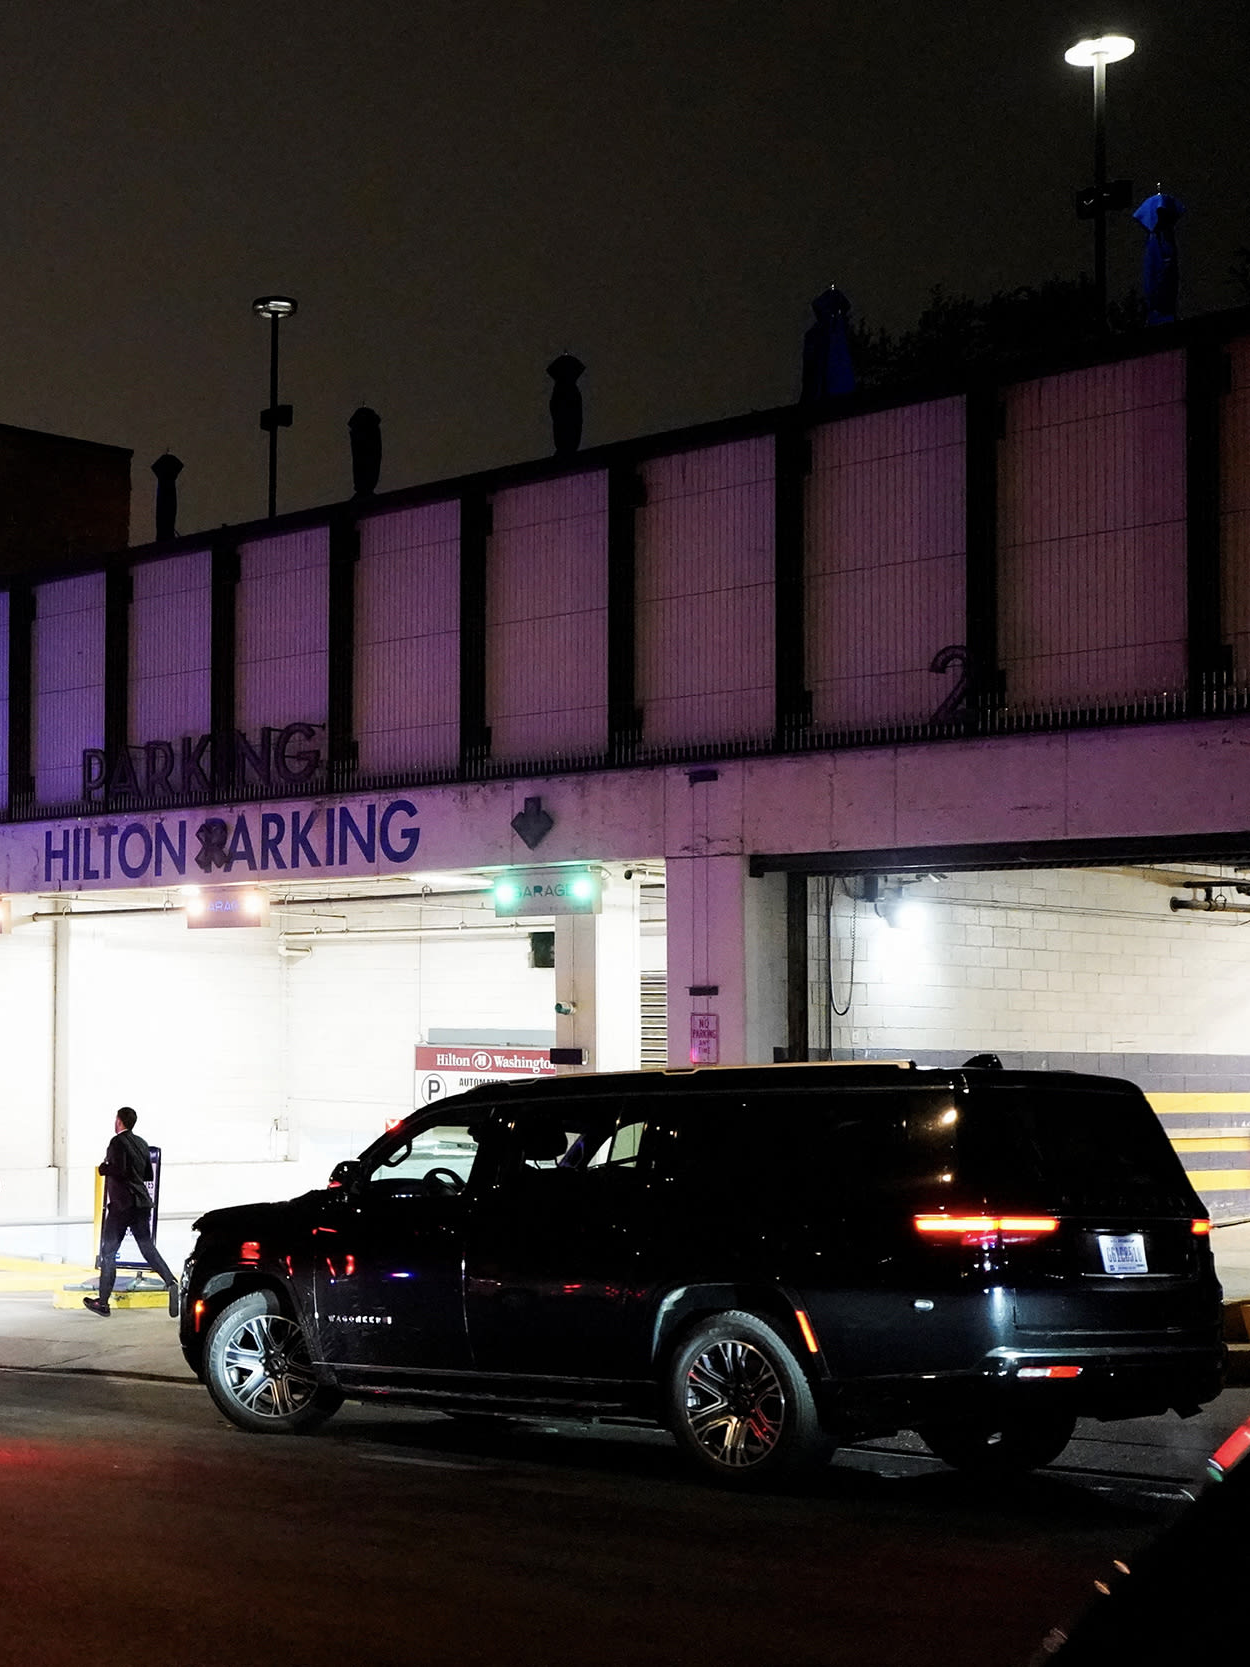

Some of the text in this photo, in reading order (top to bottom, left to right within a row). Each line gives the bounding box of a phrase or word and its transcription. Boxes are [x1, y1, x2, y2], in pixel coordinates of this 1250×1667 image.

[82, 722, 321, 799] PARKING
[44, 820, 187, 882] HILTON
[699, 1019, 710, 1028] NO
[436, 1054, 470, 1066] Hilton
[493, 1055, 556, 1073] Washingto
[428, 1080, 440, 1100] P
